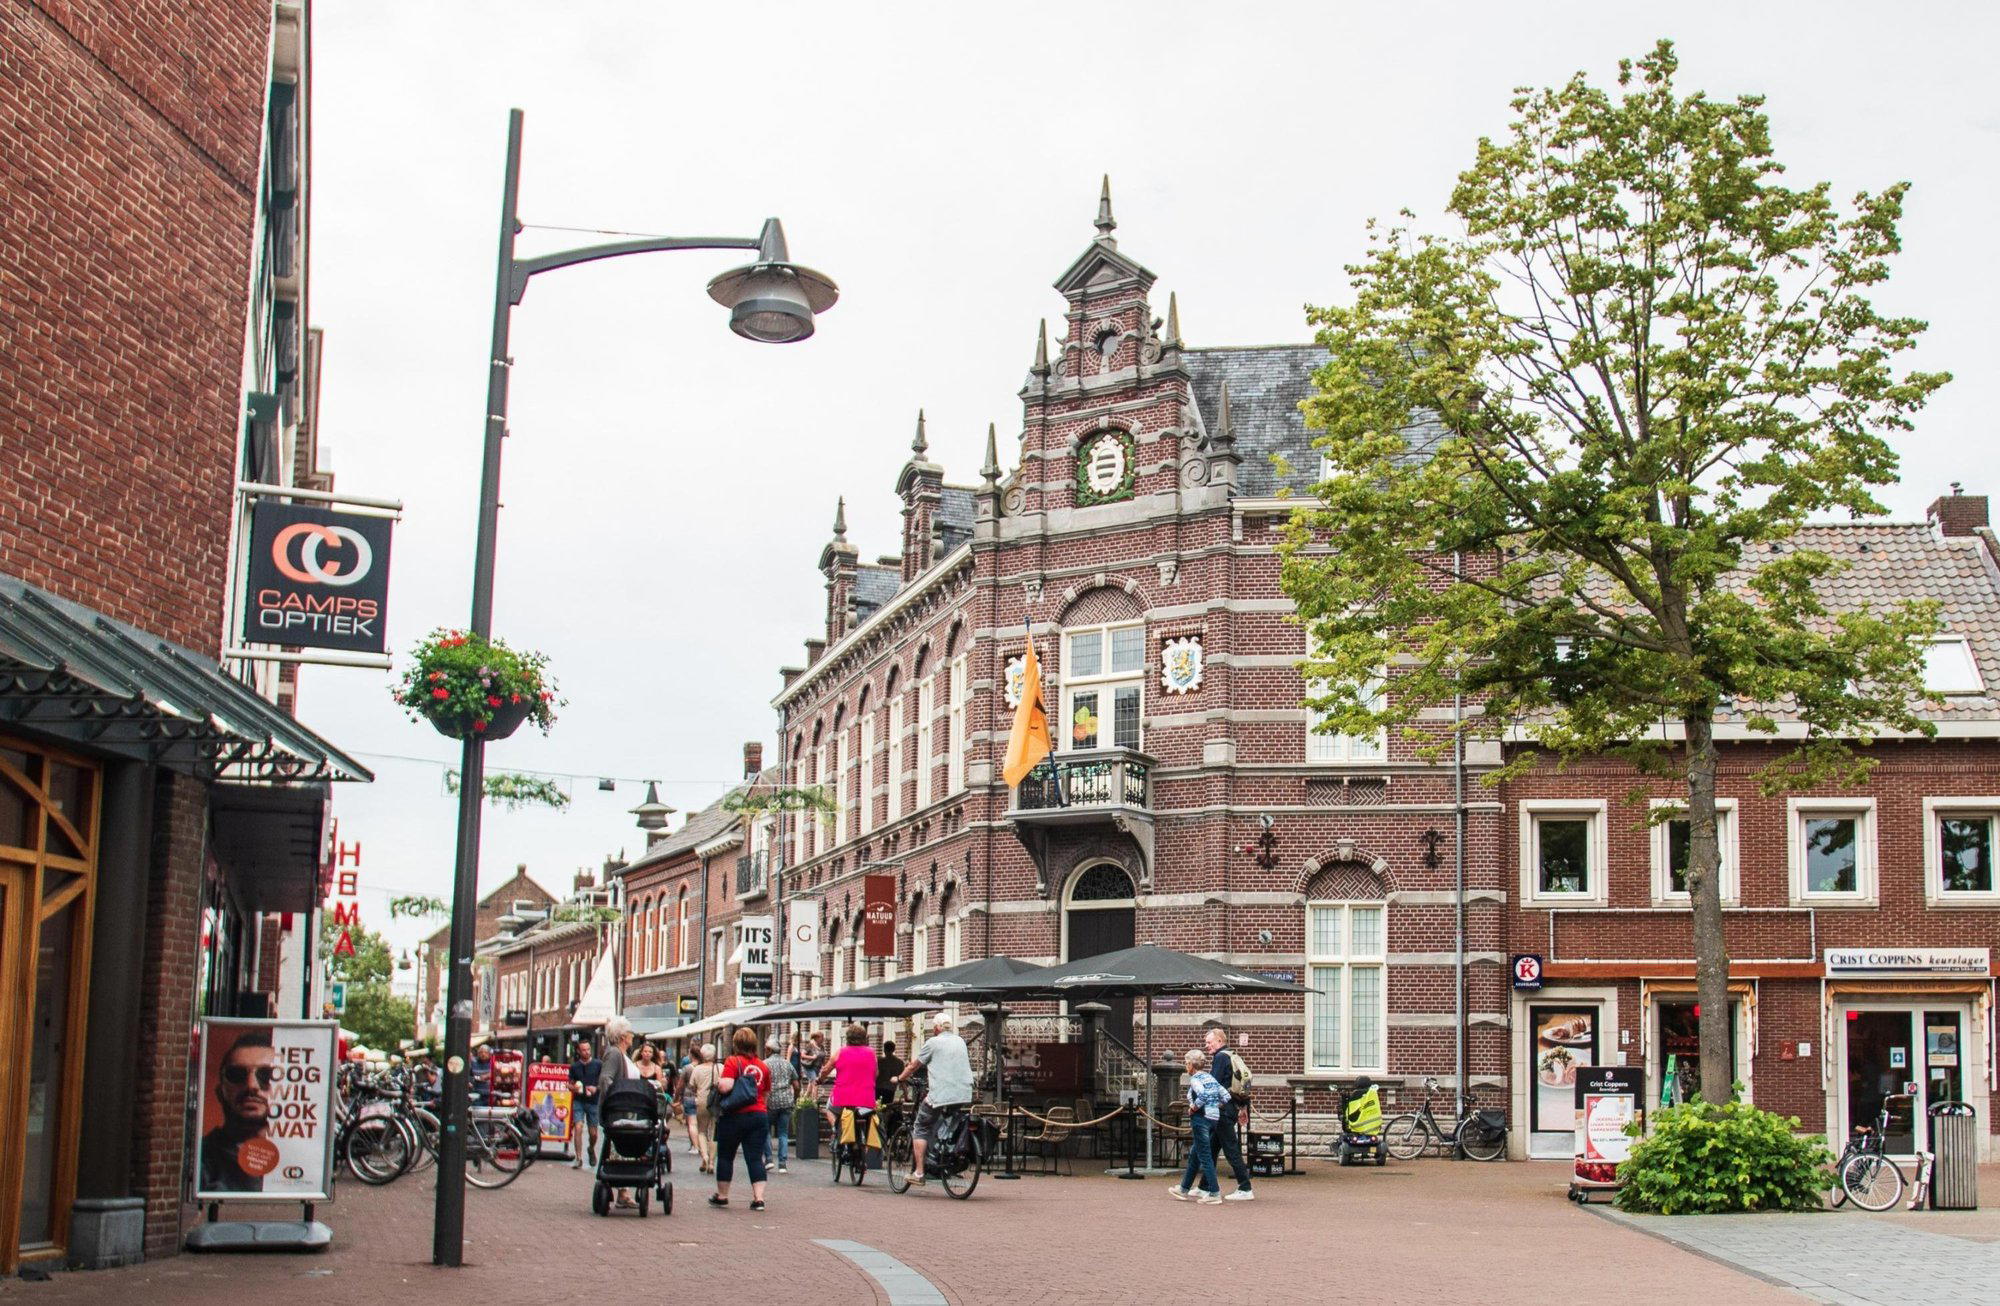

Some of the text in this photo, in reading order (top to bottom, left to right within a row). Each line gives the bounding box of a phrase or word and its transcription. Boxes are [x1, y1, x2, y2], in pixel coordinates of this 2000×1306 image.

[258, 589, 378, 618] CAMPS
[260, 608, 375, 638] OPTIEK
[333, 841, 361, 958] HEMA
[745, 927, 772, 943] IT'S
[796, 924, 812, 942] G
[747, 948, 769, 964] ME
[1830, 953, 1985, 967] CRIST COPPENS keurslager
[1519, 964, 1536, 978] K
[271, 1065, 321, 1084] OOG
[540, 1065, 570, 1075] Kruidva
[271, 1084, 311, 1102] WIL
[1589, 1080, 1629, 1089] Crist Coppens
[267, 1103, 318, 1120] OOK
[267, 1121, 318, 1139] WAT
